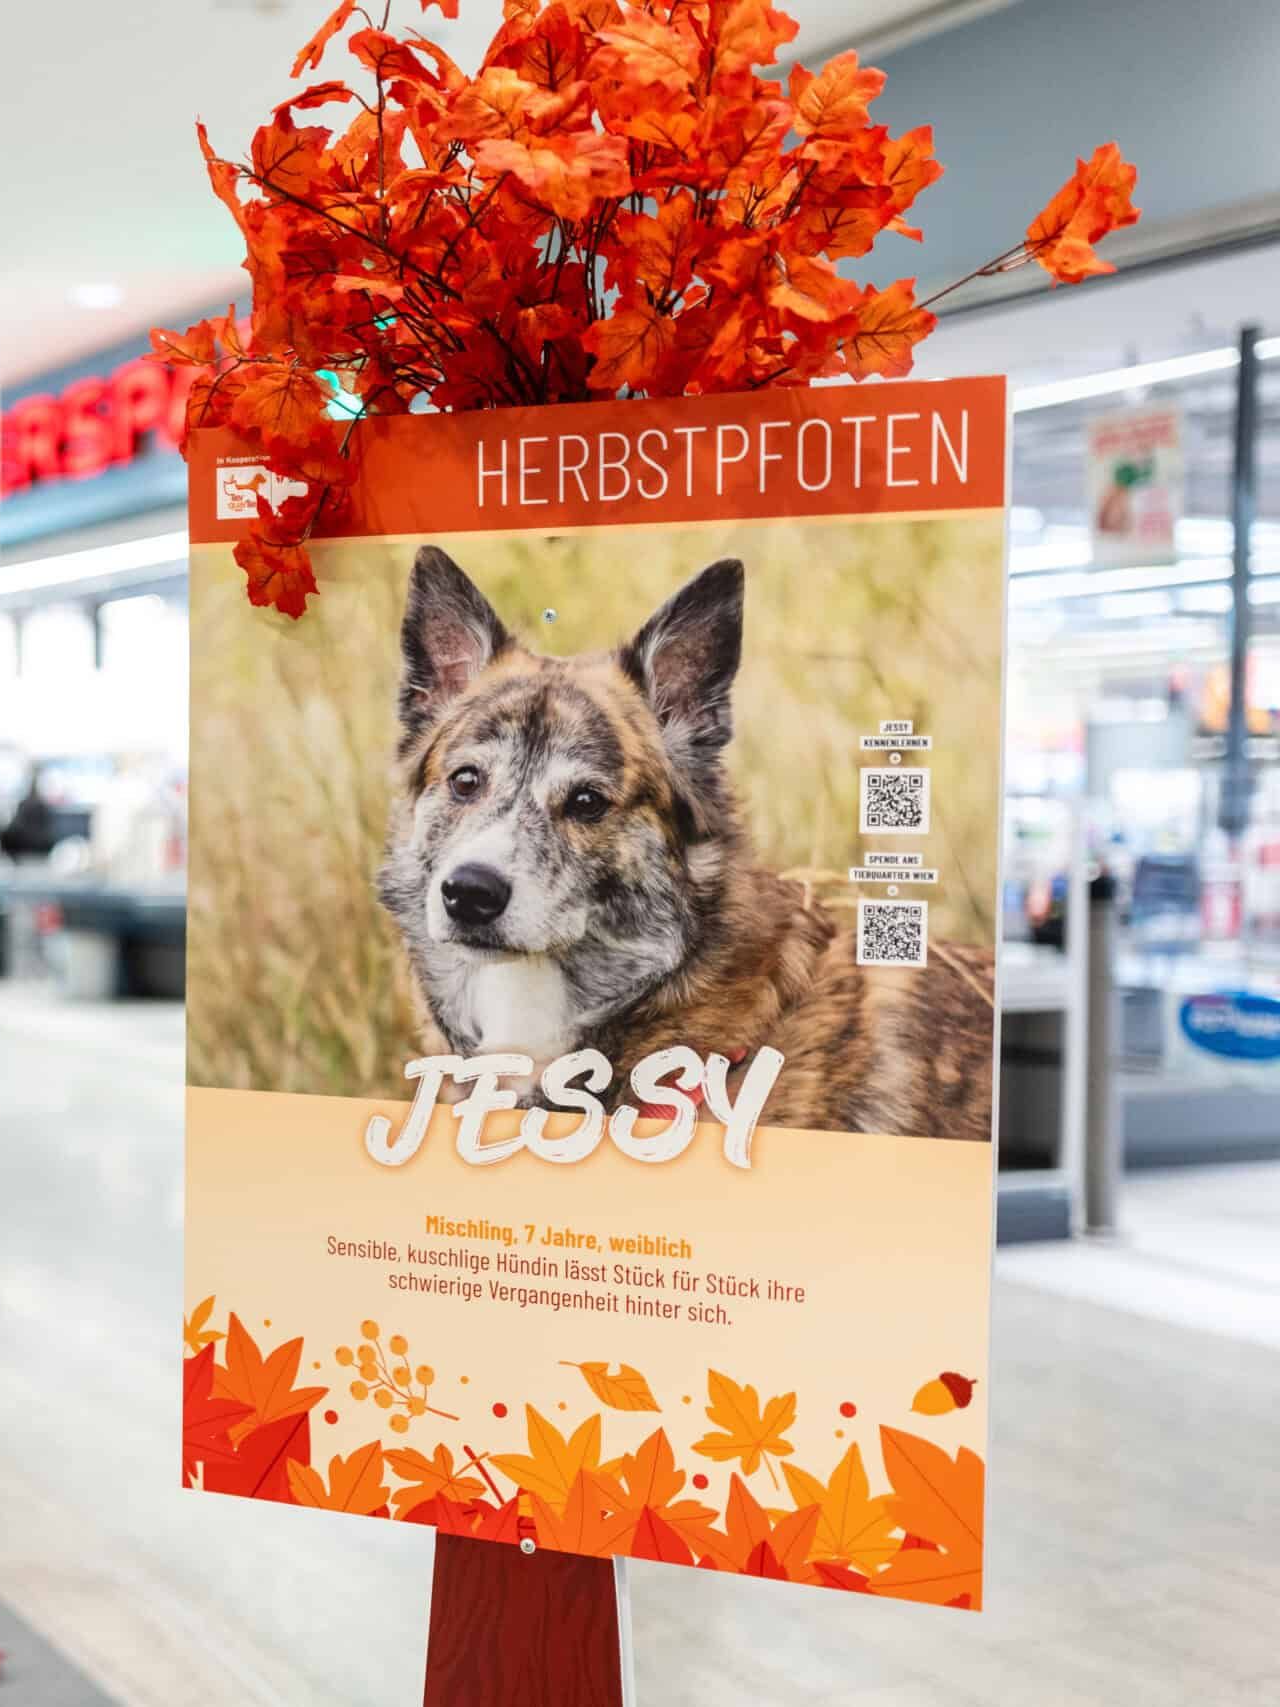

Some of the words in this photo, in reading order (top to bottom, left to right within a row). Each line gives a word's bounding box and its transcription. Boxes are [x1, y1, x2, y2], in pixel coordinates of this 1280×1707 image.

[478, 409, 968, 507] HERBSTPFOTEN
[864, 739, 928, 747] KENNENLERNEN
[884, 723, 908, 732] JESSY
[853, 870, 910, 880] TIERQUARTIER
[913, 871, 934, 881] WIEN
[869, 855, 898, 865] SPENDE
[365, 1044, 785, 1169] JESSY
[425, 1215, 519, 1246] Mischling,
[524, 1223, 536, 1244] 7
[540, 1226, 603, 1253] Jahre,
[609, 1233, 692, 1259] weiblich
[327, 1235, 401, 1263] Sensible,
[408, 1243, 490, 1274] kuschlige
[497, 1252, 558, 1277] Hündin
[564, 1259, 607, 1283] lässt
[613, 1263, 665, 1289] Stück
[672, 1269, 700, 1293] für
[706, 1272, 760, 1299] Stück
[767, 1279, 806, 1304] ihre
[388, 1271, 482, 1302] schwierige
[488, 1279, 619, 1313] Vergangenheit
[625, 1295, 681, 1319] hinter
[687, 1302, 733, 1326] sich.
